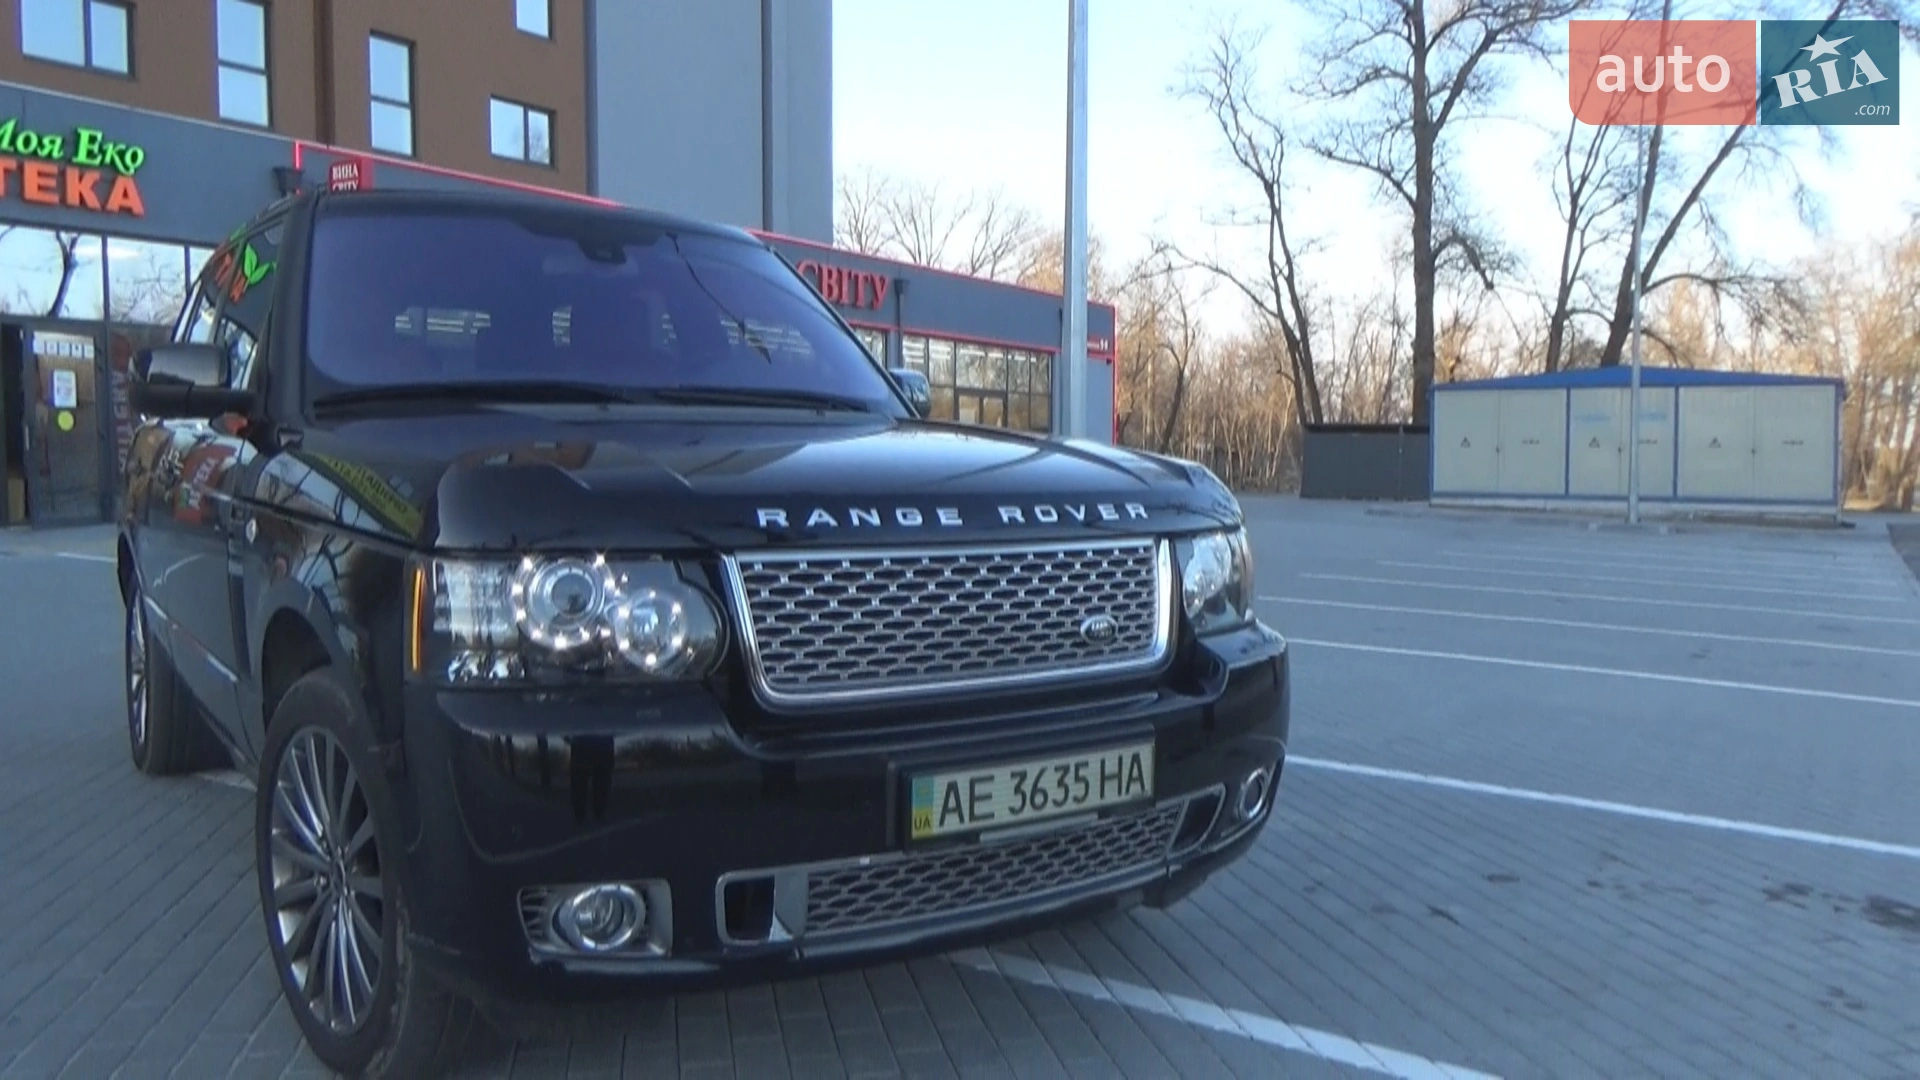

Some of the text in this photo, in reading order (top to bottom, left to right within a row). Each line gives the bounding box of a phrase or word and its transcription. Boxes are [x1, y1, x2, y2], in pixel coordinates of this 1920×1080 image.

[71, 127, 145, 176] Еко
[332, 163, 359, 180] ВИНА
[756, 502, 1148, 528] RANGE ROVER
[939, 774, 995, 828] AE
[1008, 760, 1090, 816] 3635
[914, 816, 931, 831] UA
